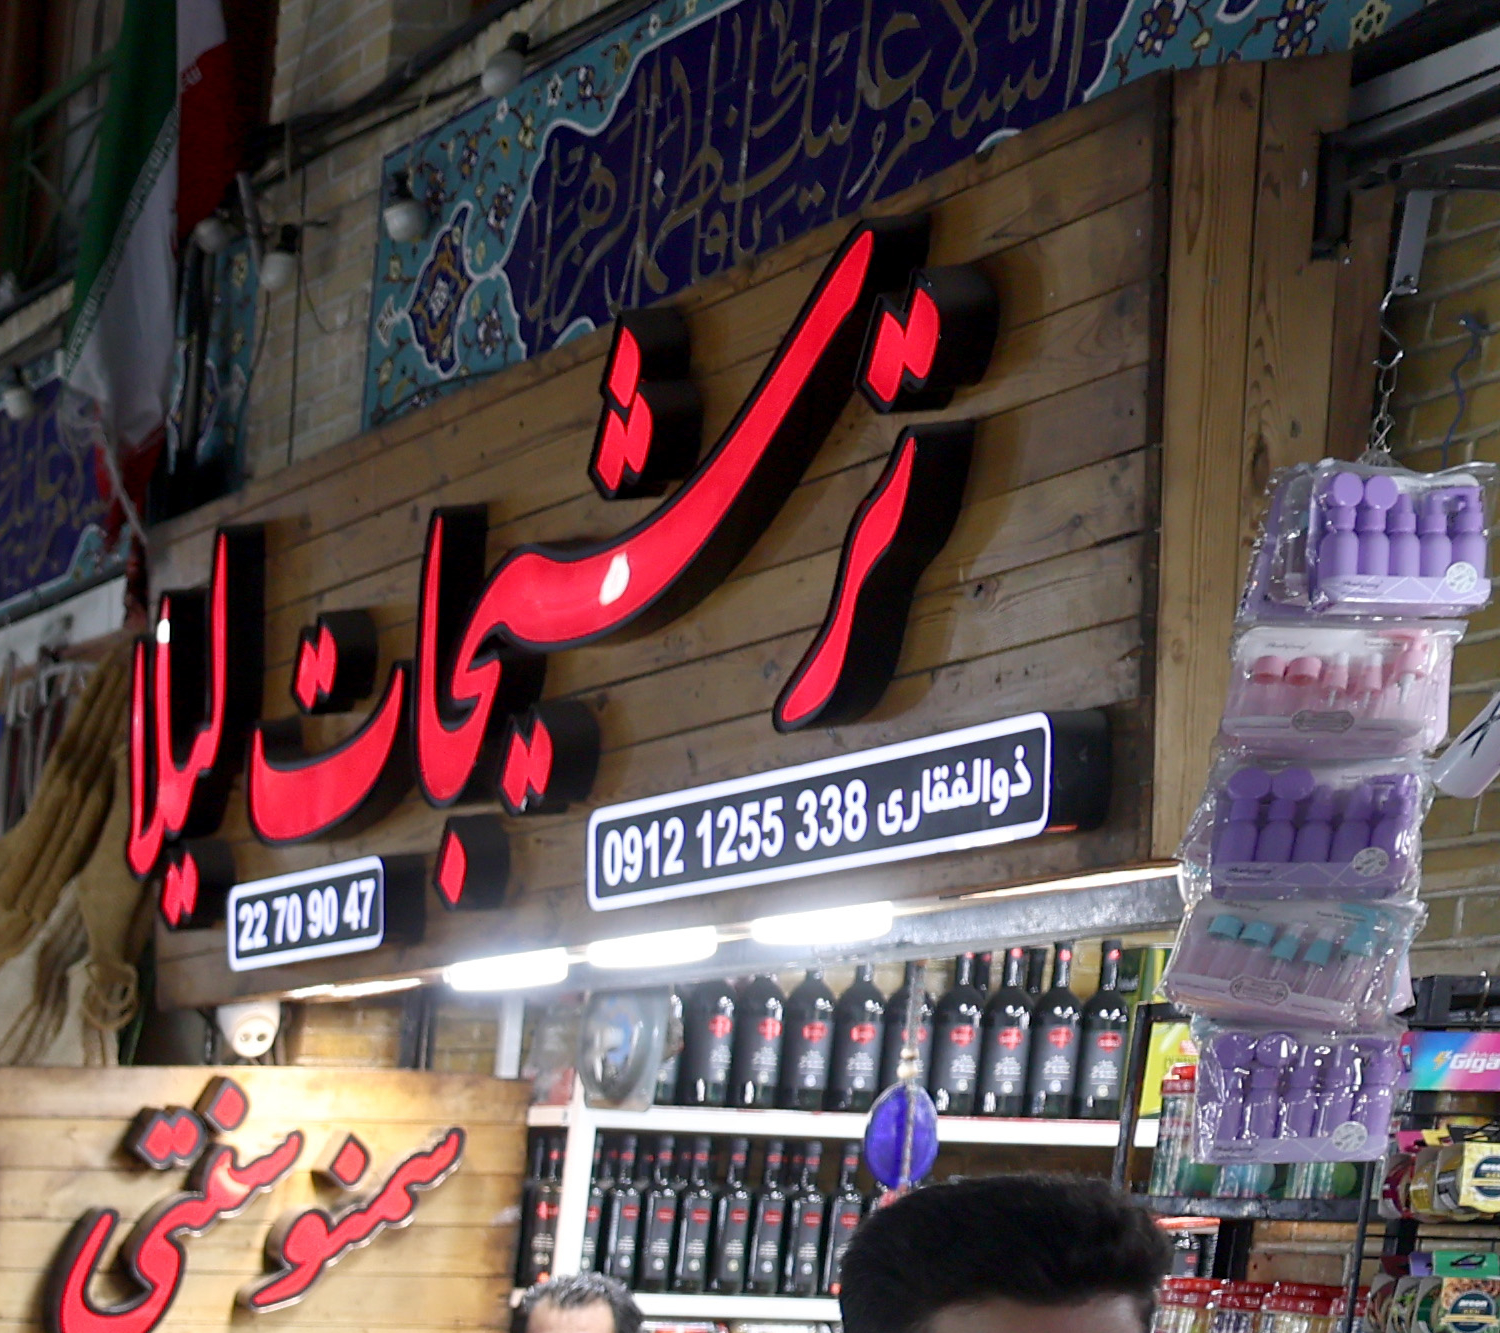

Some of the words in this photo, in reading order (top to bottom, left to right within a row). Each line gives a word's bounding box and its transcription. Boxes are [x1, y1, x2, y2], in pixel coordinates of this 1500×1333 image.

[250, 226, 942, 910] ترشیجات
[126, 526, 228, 926] لیلا
[602, 816, 685, 887] 0912
[695, 796, 785, 869] 1255
[795, 778, 868, 851] 338
[877, 744, 1033, 837] ذوالفقاری
[237, 899, 269, 952] 22
[272, 892, 303, 946] 70
[306, 885, 339, 940] 90
[342, 877, 377, 931] 47
[250, 1128, 464, 1310] سمنو
